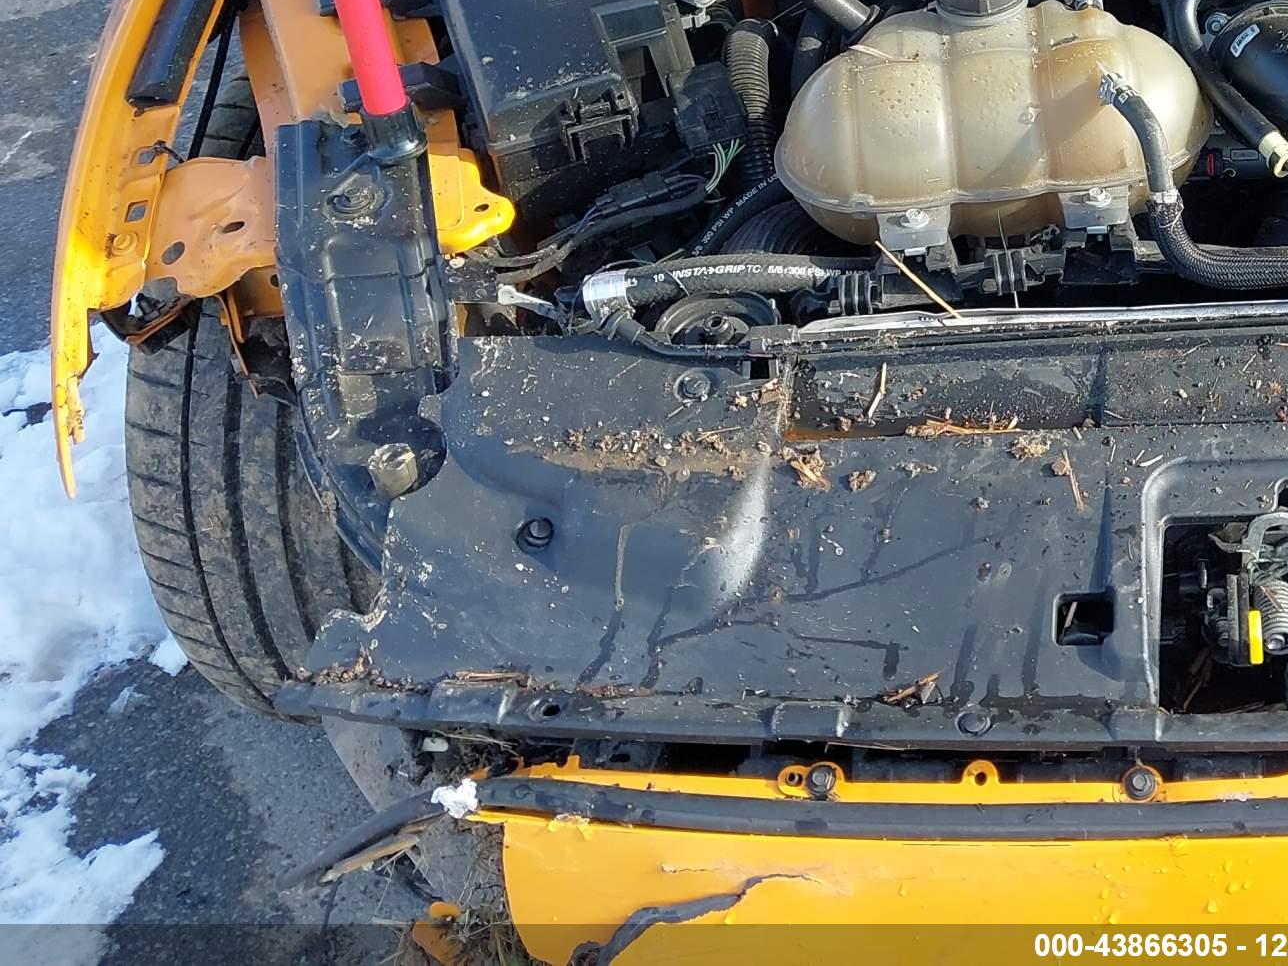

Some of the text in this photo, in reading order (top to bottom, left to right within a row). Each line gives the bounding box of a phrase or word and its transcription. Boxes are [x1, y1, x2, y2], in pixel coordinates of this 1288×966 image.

[701, 231, 714, 244] 300
[711, 218, 725, 232] PSI
[721, 207, 734, 220] WP
[735, 187, 759, 207] MADE
[758, 179, 768, 190] IN
[653, 273, 665, 283] 10
[746, 264, 762, 274] TC
